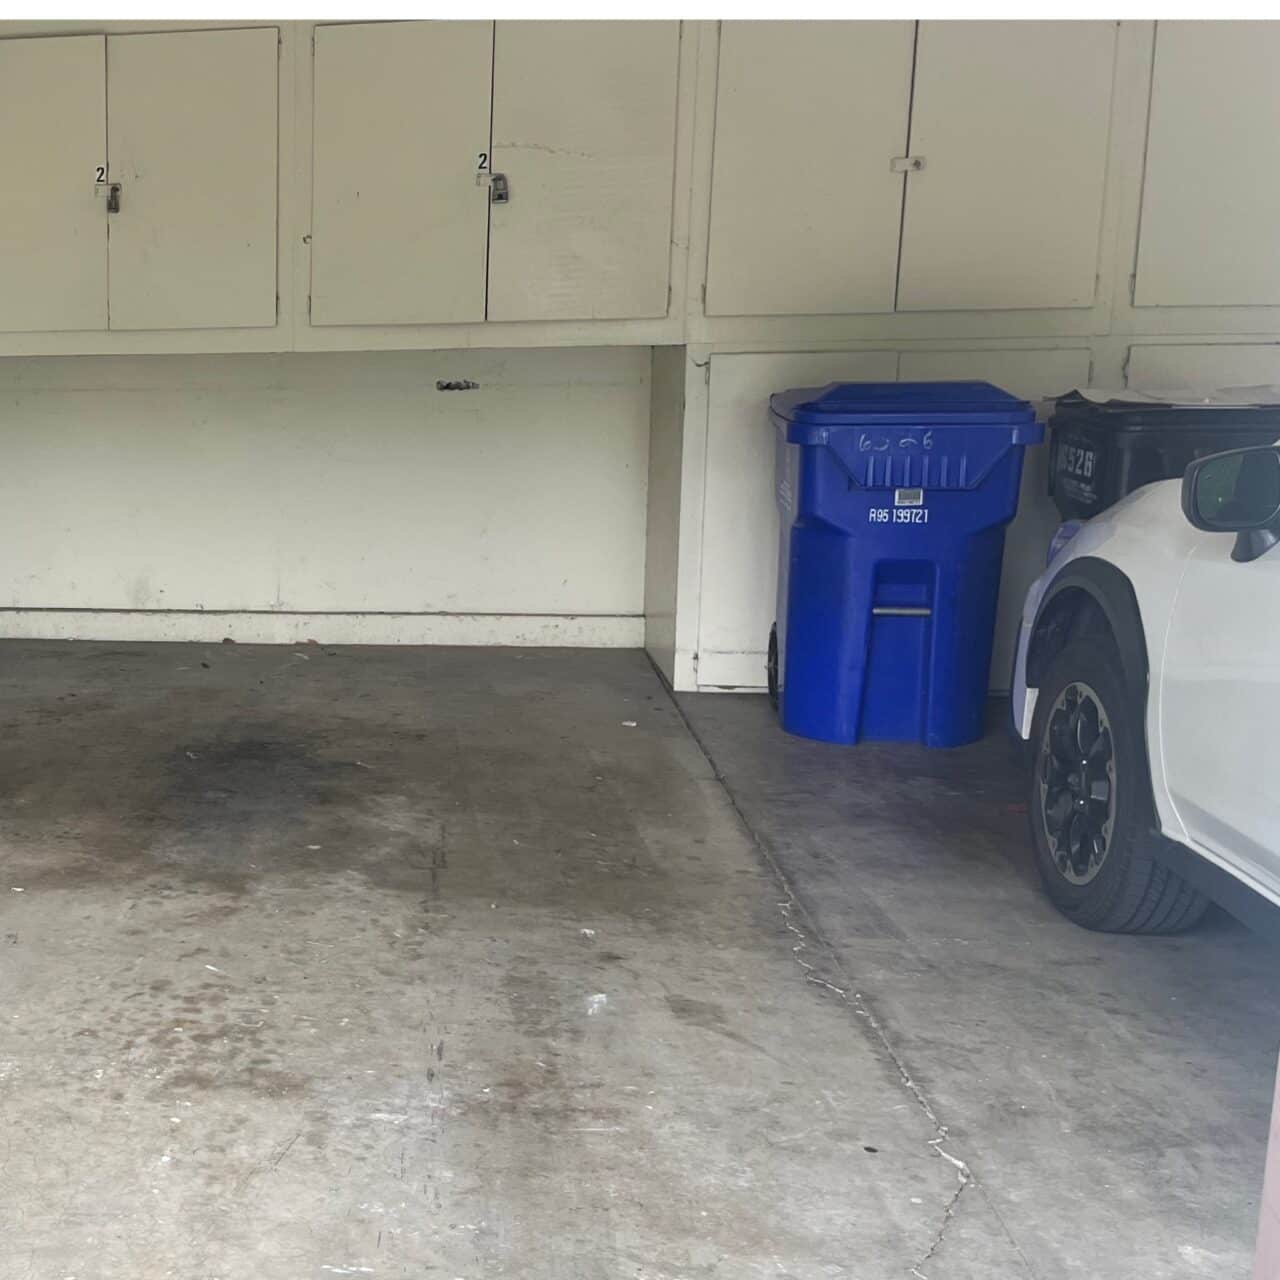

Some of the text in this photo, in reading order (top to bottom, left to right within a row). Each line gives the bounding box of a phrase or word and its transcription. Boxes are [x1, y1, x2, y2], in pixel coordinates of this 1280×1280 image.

[478, 153, 487, 169] 2
[96, 167, 105, 182] 2
[892, 508, 928, 523] 199721
